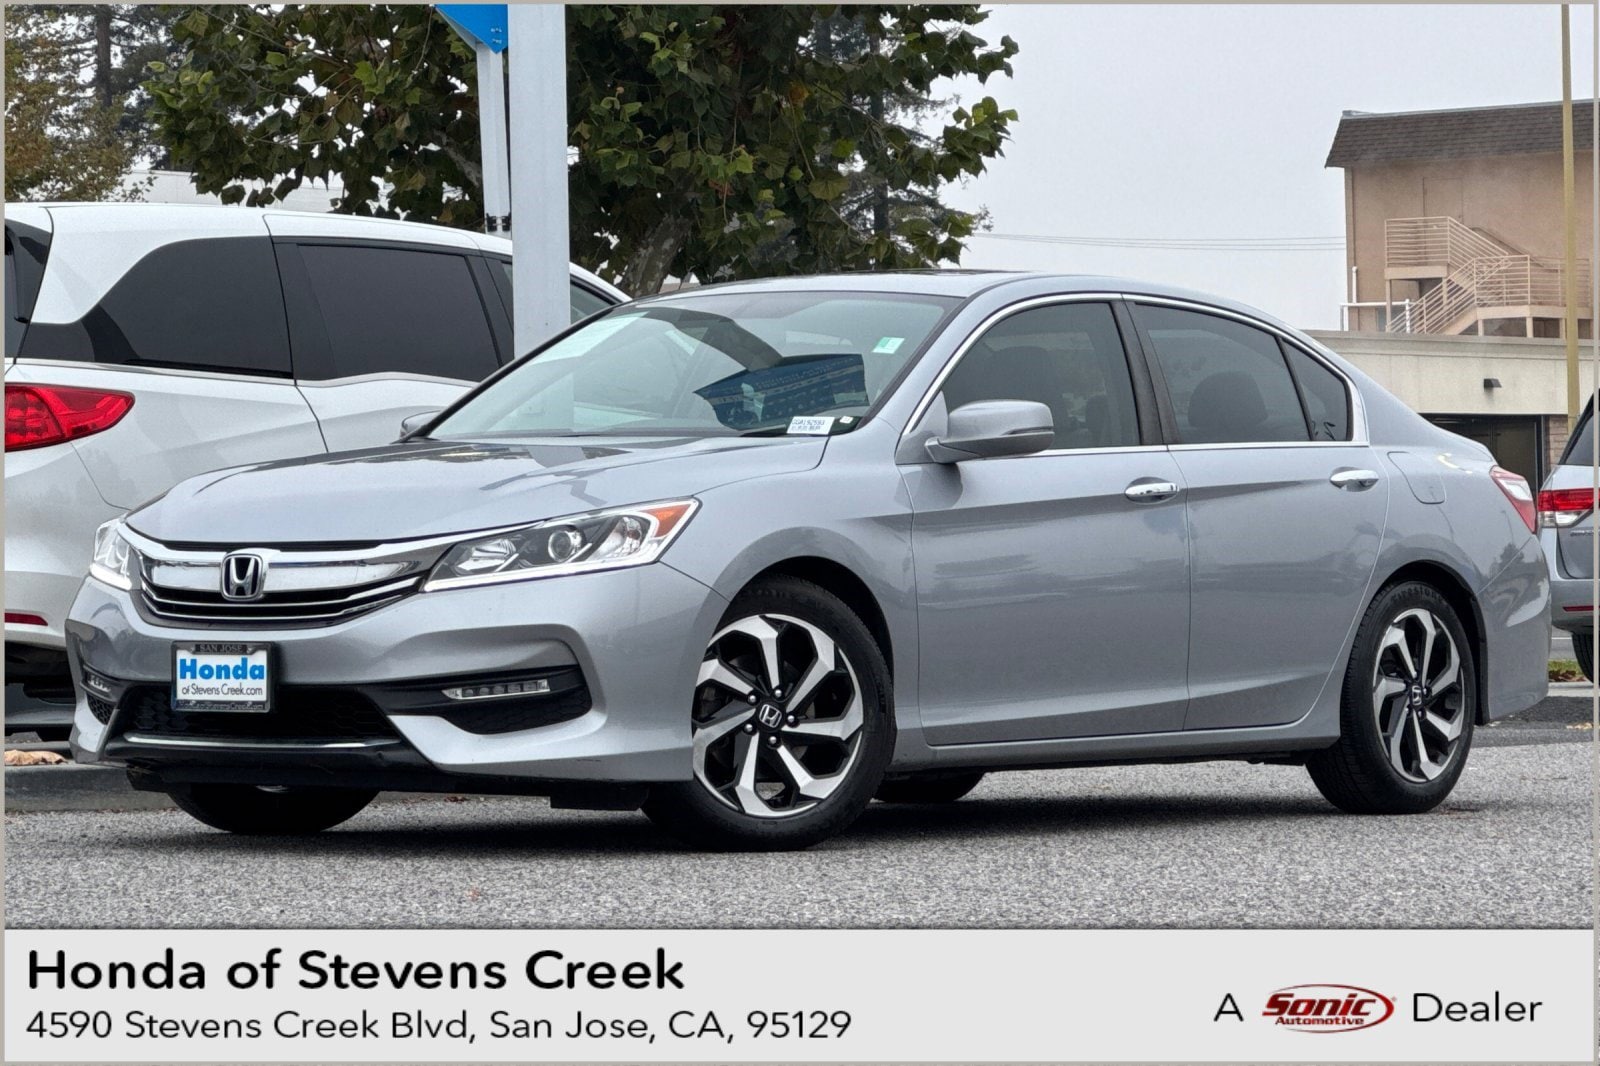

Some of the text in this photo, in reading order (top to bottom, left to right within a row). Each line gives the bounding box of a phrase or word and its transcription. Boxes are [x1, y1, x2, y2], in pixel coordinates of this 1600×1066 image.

[199, 643, 242, 652] SAN JOSE
[179, 657, 265, 680] Honda
[191, 683, 220, 695] Stevens
[221, 682, 263, 696] Creek.com
